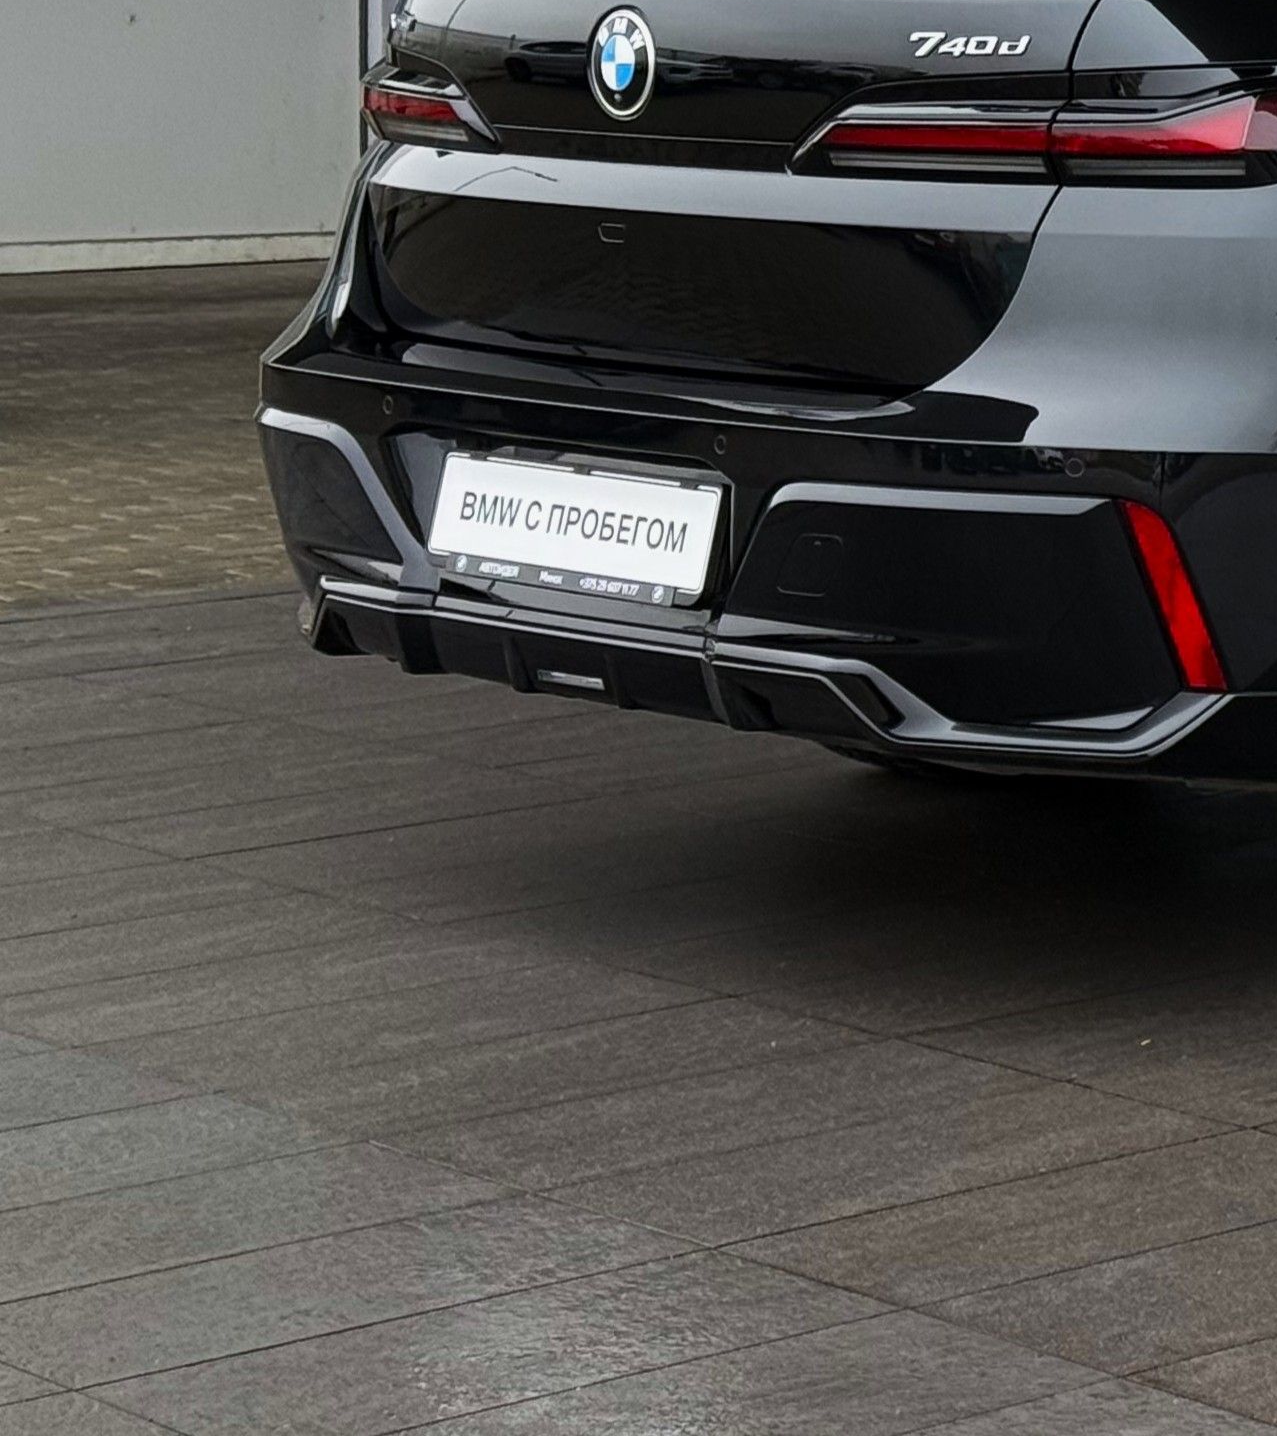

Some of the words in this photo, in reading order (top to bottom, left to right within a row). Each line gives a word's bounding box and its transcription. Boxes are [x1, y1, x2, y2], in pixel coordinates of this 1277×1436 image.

[909, 31, 1031, 57] 740d
[459, 491, 522, 528] BMW
[546, 503, 688, 554] ПРОБЕГОМ
